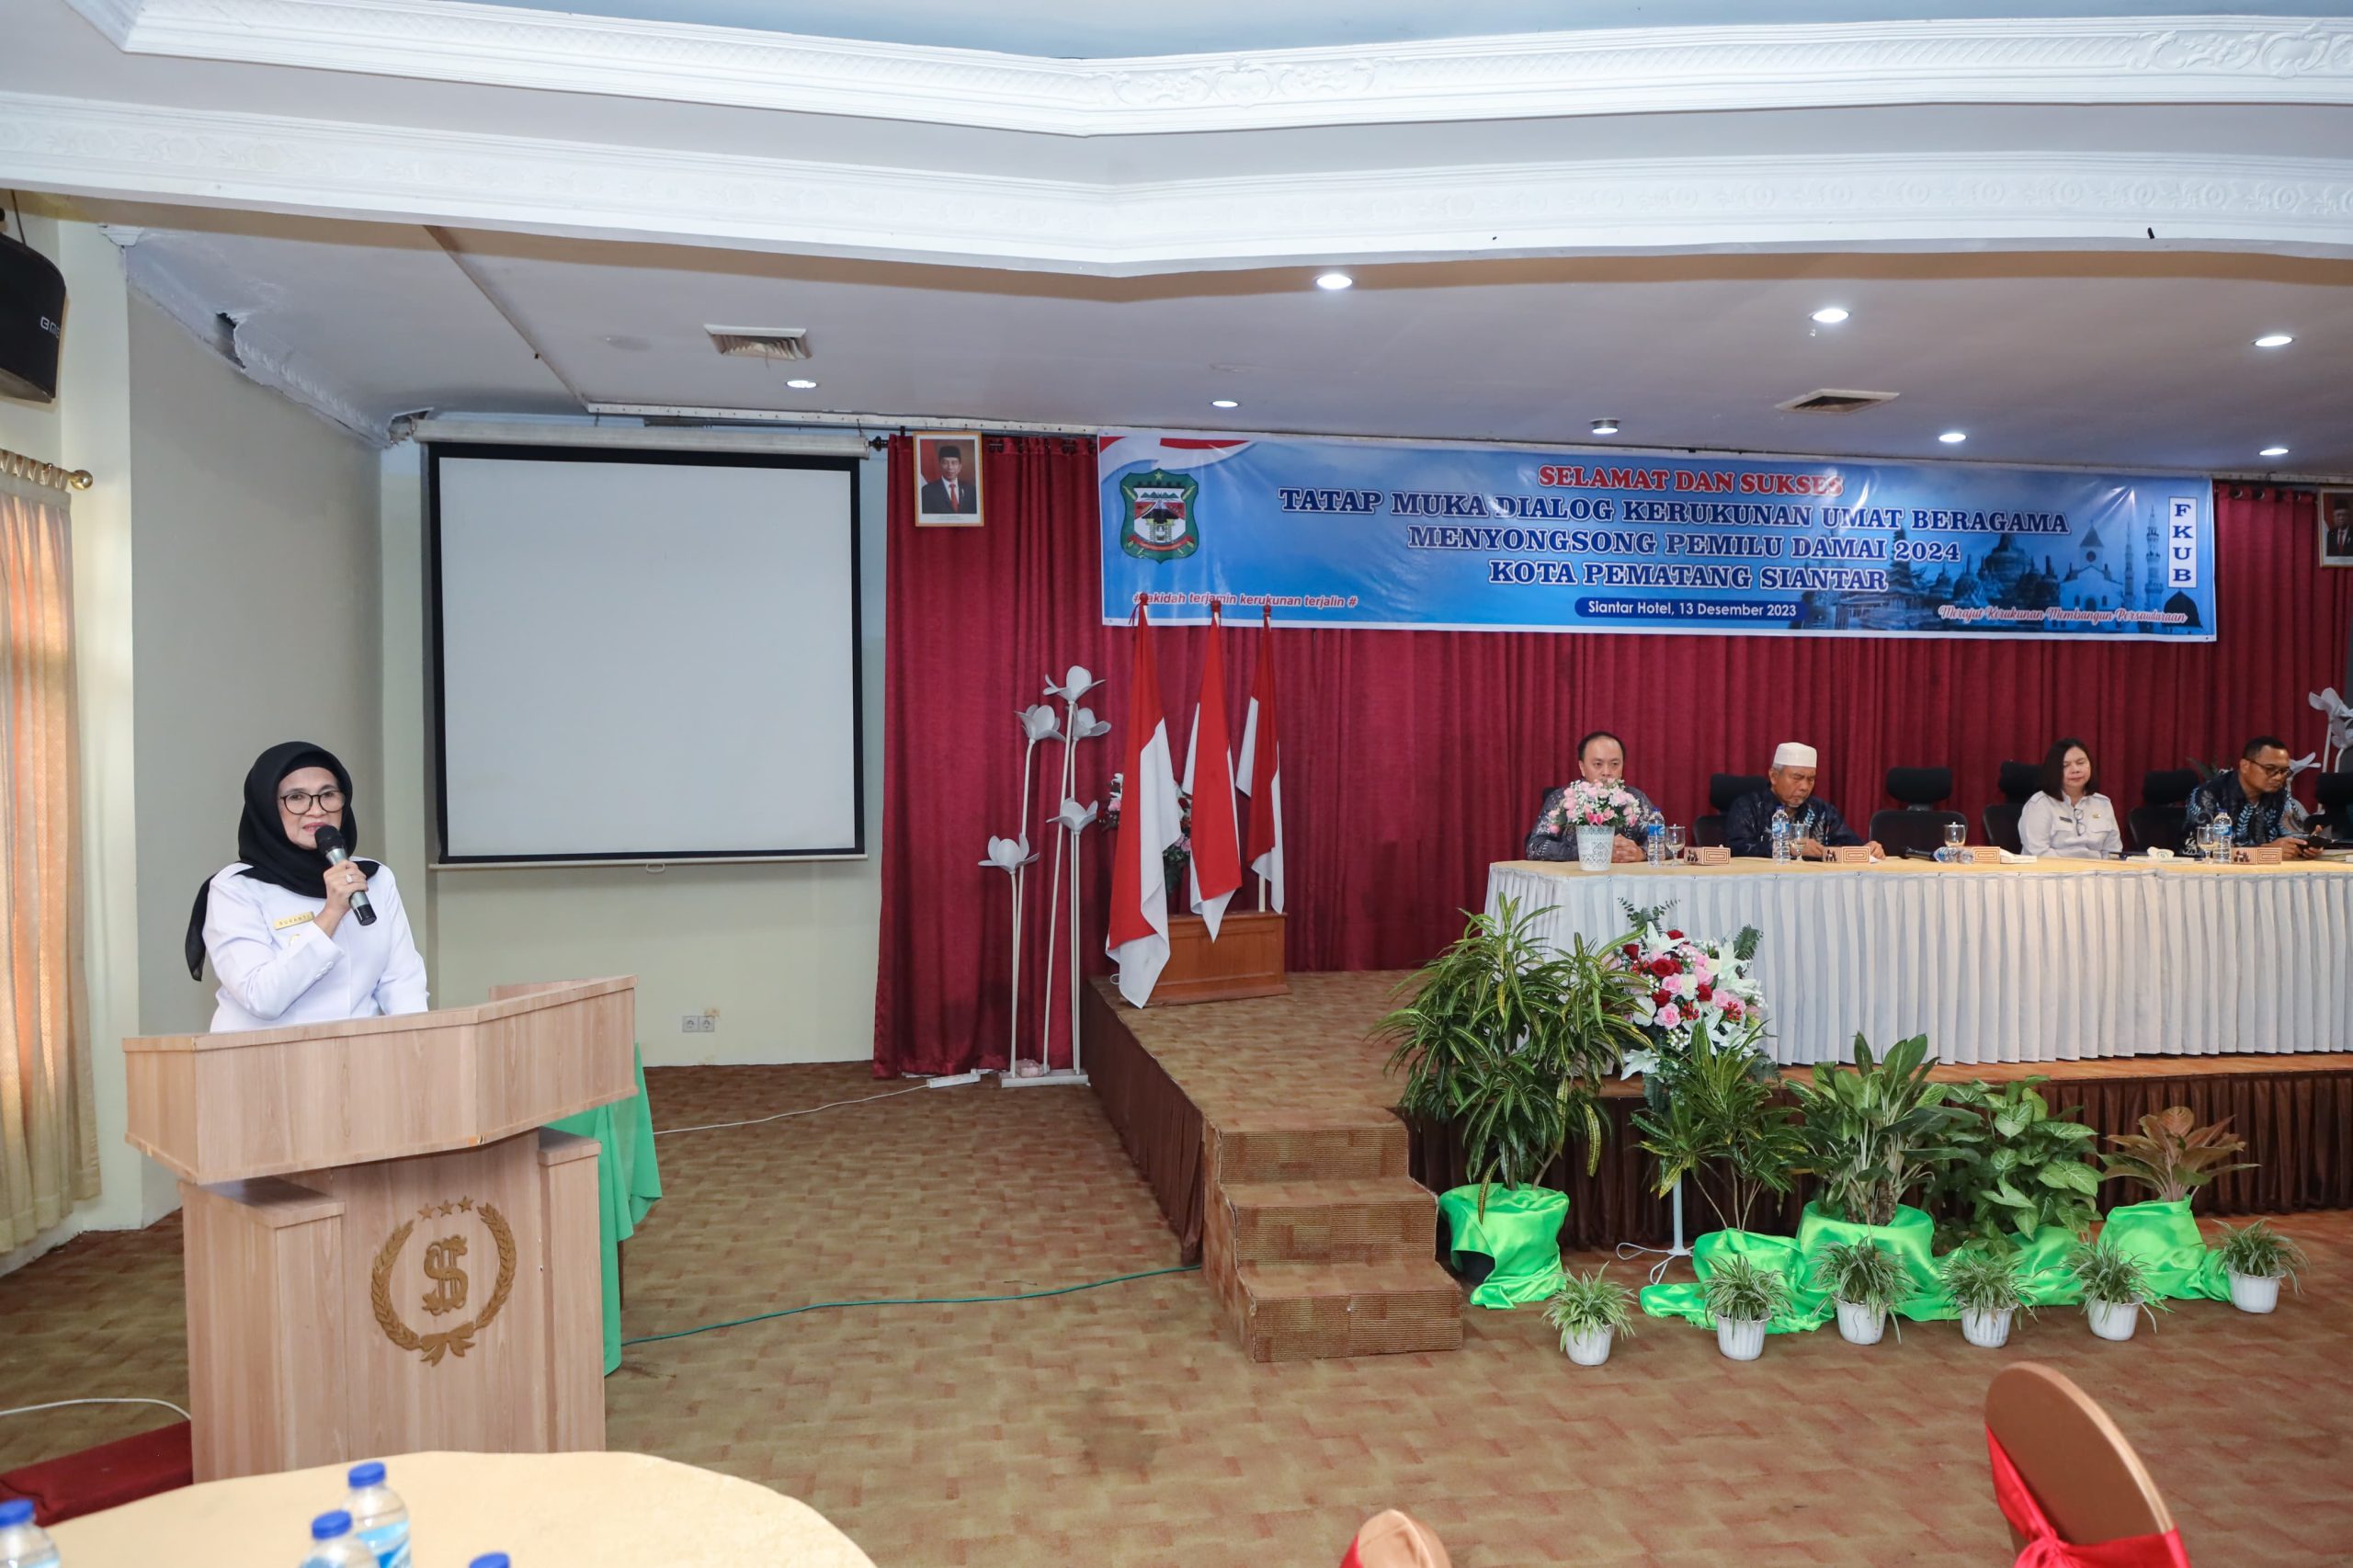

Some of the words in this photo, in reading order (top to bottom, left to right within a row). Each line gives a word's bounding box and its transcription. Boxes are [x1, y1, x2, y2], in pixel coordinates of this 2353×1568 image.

[1539, 465, 1668, 490] SELAMAT
[1675, 471, 1734, 494] DAN
[1740, 473, 1844, 496] SUKSES
[1279, 488, 1382, 514] TATAP
[1391, 492, 1489, 517] MUKA
[1495, 495, 1614, 521] DIALOG
[1621, 501, 1812, 527] KERUKUNAN
[1822, 507, 1904, 530] UMAT
[1911, 509, 2070, 534] BERAGAMA
[1408, 526, 1657, 554] MENYONGSONG
[1665, 533, 1784, 558] PEMILU
[1790, 537, 1887, 560] DAMAI
[1893, 540, 1961, 562] 2024
[1489, 560, 1577, 585] KOTA
[1582, 562, 1752, 589] PEMATANG
[1760, 565, 1888, 591] SIANTAR
[1188, 593, 1237, 606] terjamin
[1240, 594, 1302, 607] kerukunan
[1304, 596, 1345, 608] terjalin
[1588, 600, 1633, 614] Siantar
[1637, 601, 1675, 615] Hotel,
[1679, 602, 1694, 615] 13
[1698, 603, 1763, 617] Desember
[1767, 605, 1797, 617] 2023
[1938, 605, 1985, 623] Merajut
[1985, 606, 2044, 620] Kerukunan
[2045, 608, 2114, 625] Membangun
[2115, 608, 2188, 623] Persaudaraan
